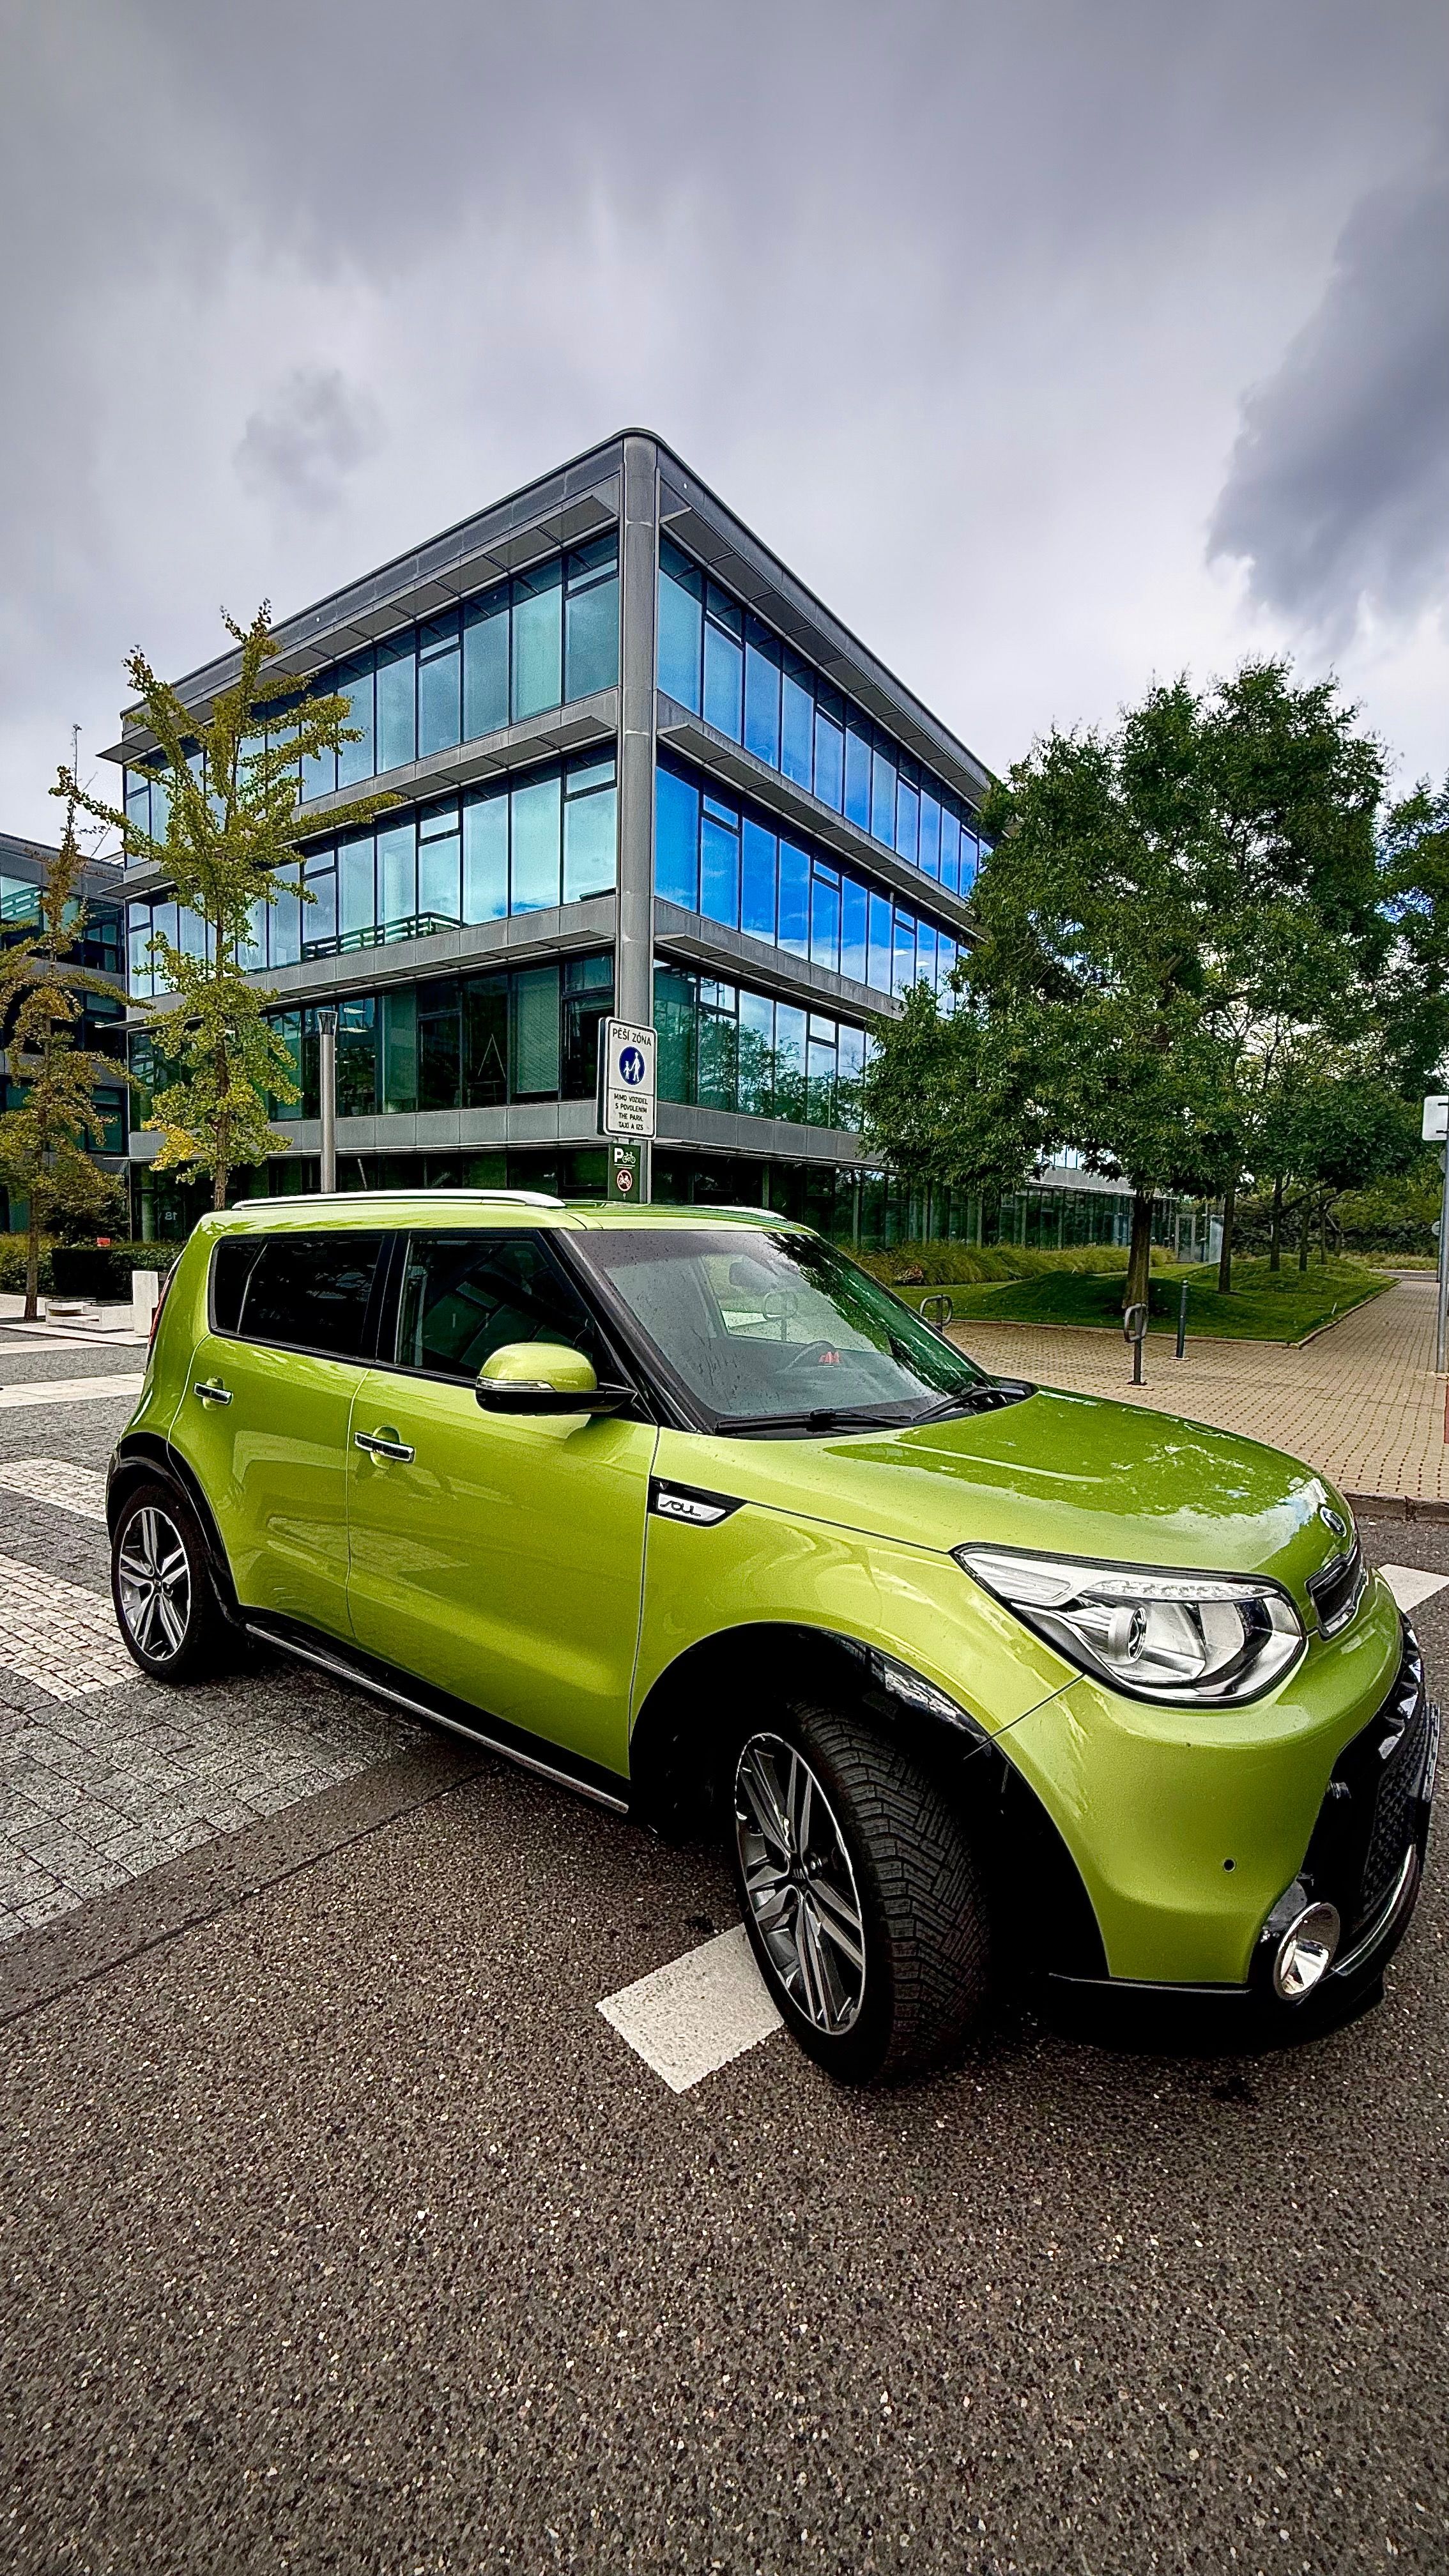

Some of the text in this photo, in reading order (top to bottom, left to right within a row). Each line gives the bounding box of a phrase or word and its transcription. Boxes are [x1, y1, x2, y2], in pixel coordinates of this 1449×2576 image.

[613, 1028, 652, 1046] PĚŠÍ ZÓNA
[629, 1096, 648, 1105] VOZIDEL
[614, 1147, 624, 1163] P
